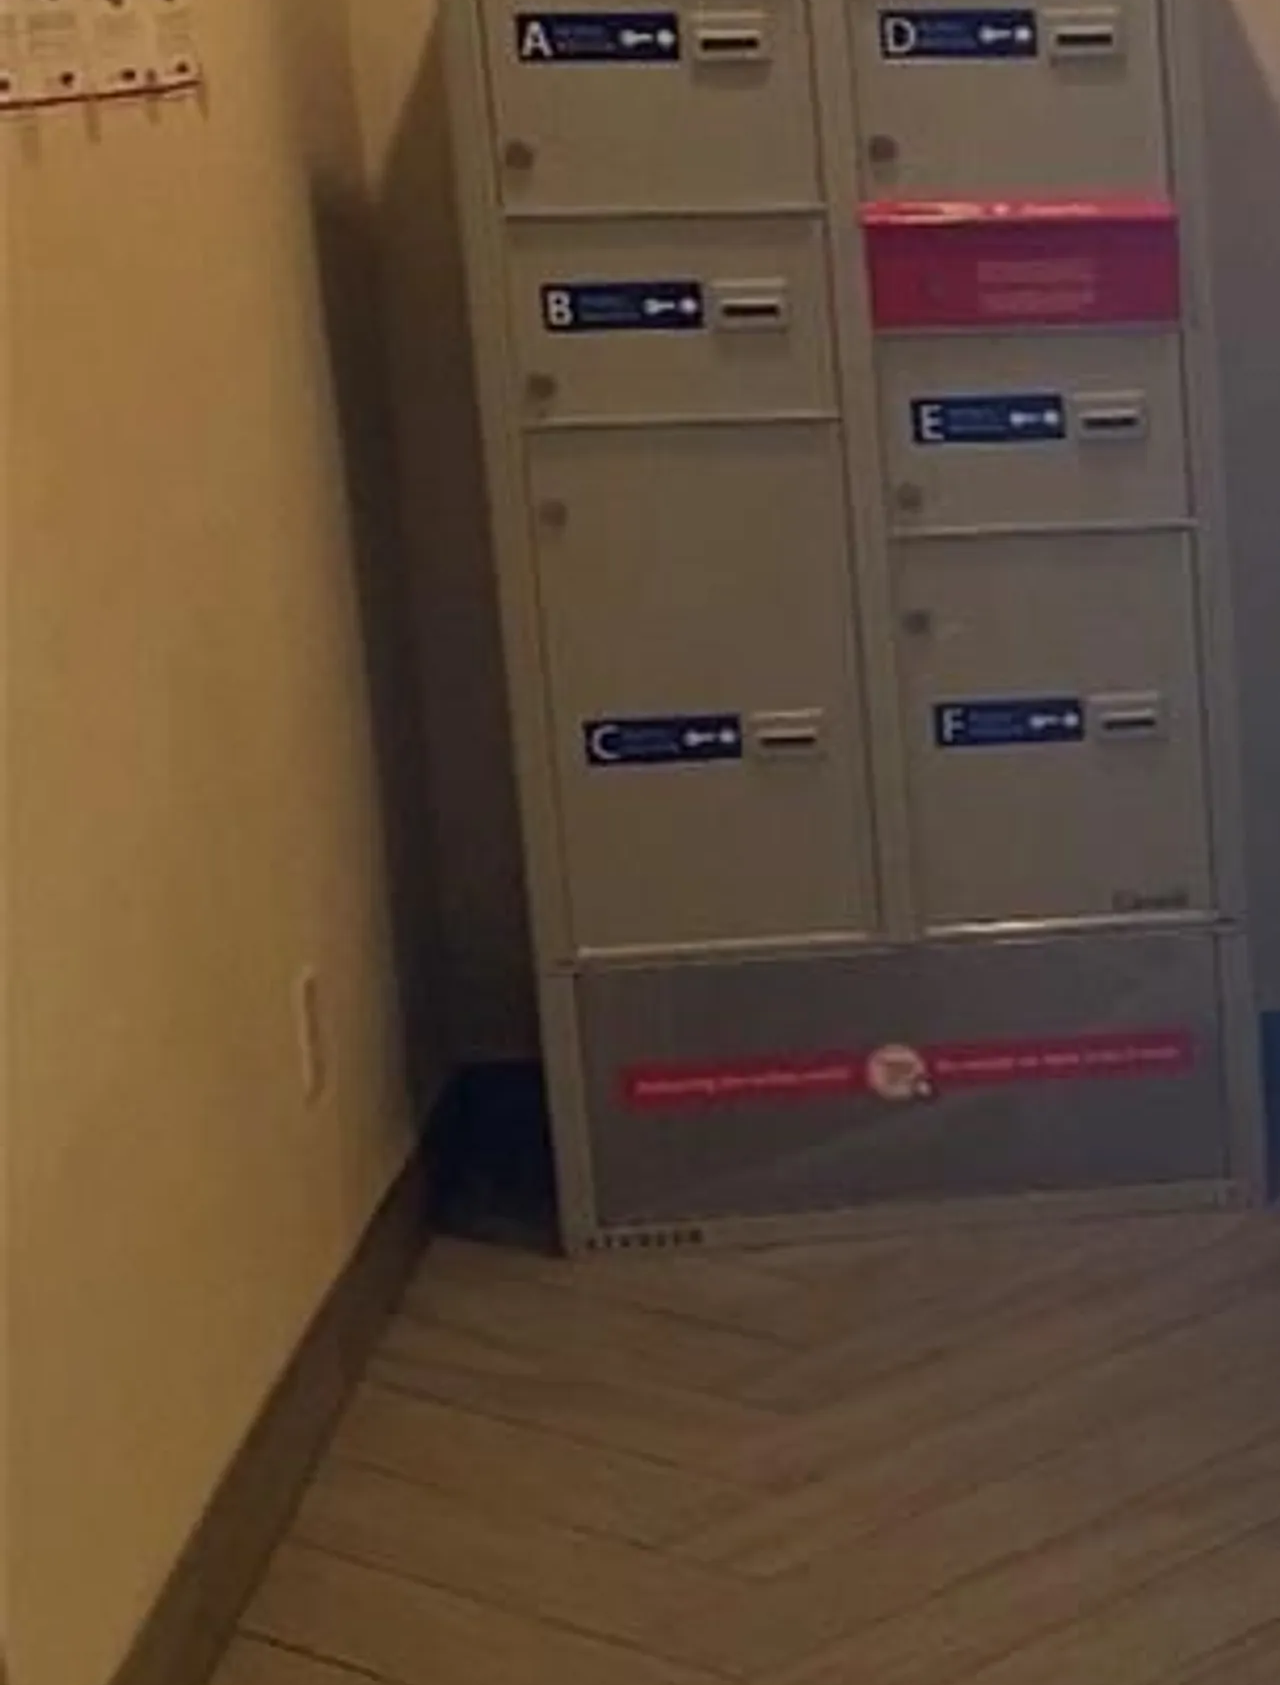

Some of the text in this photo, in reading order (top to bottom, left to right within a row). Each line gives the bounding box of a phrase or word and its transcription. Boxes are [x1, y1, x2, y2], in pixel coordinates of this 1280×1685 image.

[520, 21, 553, 57] A
[884, 18, 916, 54] D
[546, 290, 574, 326] B
[919, 404, 945, 441] E
[590, 723, 621, 760] C
[942, 707, 965, 743] F
